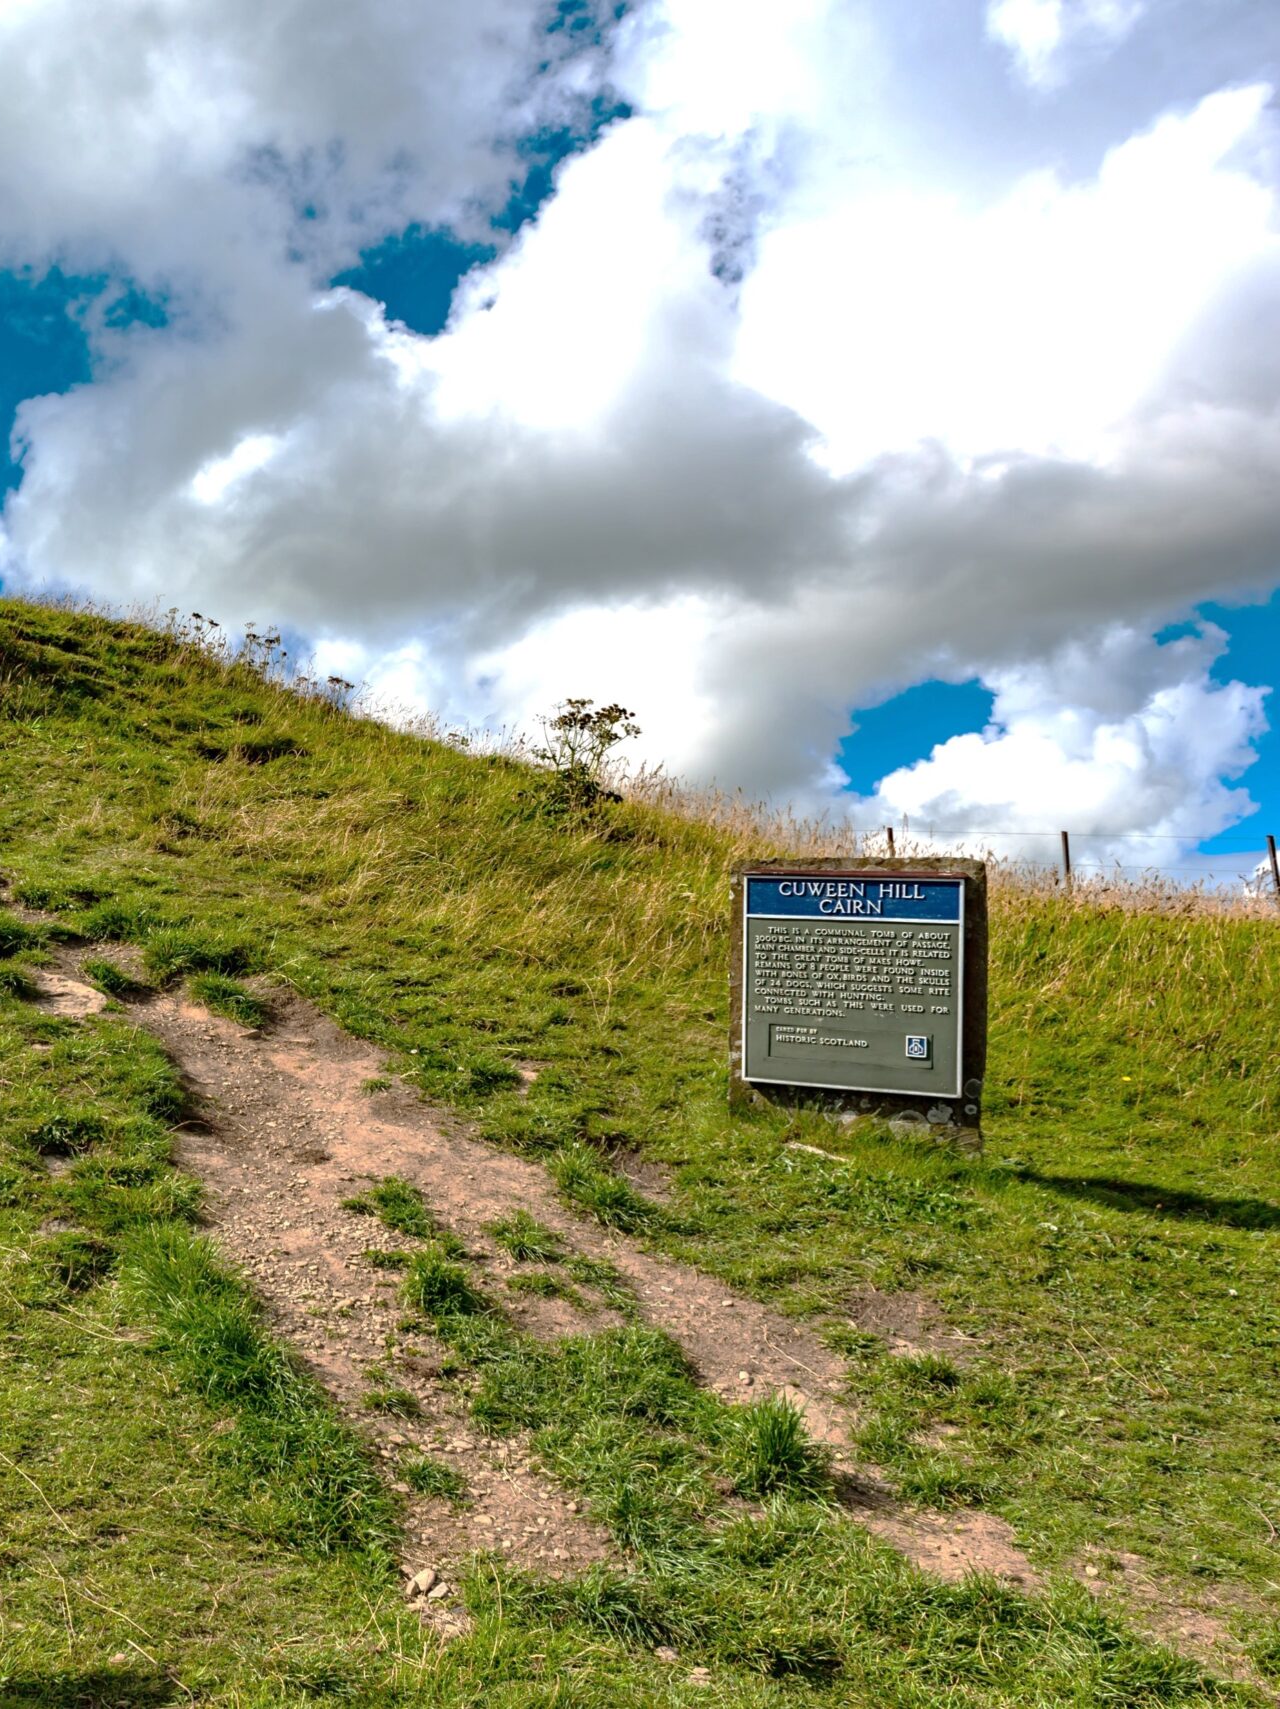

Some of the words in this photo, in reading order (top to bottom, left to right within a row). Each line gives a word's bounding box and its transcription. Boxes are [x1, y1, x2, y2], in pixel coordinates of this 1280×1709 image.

[778, 881, 864, 897] CUWEEN
[879, 883, 925, 899] HILL
[818, 899, 881, 914] CAIRN
[767, 926, 786, 934] THIS
[814, 928, 865, 936] COMMUNAL
[870, 929, 895, 938] TOMB
[901, 930, 913, 938] OF
[918, 931, 950, 940] ABOUT
[826, 937, 891, 946] ARRANGEMENT
[825, 955, 848, 963] TOMB
[869, 957, 891, 965] MAES
[912, 950, 950, 958] RELATED
[754, 960, 790, 969] REMAINS
[810, 962, 815, 970] 8
[819, 963, 849, 971] PEOPLE
[854, 965, 878, 973] WERE
[883, 966, 914, 974] FOUND
[920, 968, 949, 976] INSIDE
[755, 969, 777, 977] WITH
[781, 970, 807, 978] BONES
[918, 977, 949, 985] SKULLS
[754, 987, 806, 996] CONNECTED
[811, 990, 834, 998] WITH
[840, 992, 884, 1001] HUNTING.
[816, 981, 845, 989] WHICH
[850, 983, 892, 992] SUGGESTS
[928, 987, 949, 995] RITE
[754, 1004, 778, 1012] MANY
[783, 1006, 845, 1016] GENERATIONS.
[764, 996, 792, 1004] TOMBS
[798, 998, 820, 1006] SUCH
[826, 999, 836, 1007] AS
[843, 1000, 863, 1008] THIS
[870, 1002, 894, 1010] WERE
[900, 1004, 924, 1012] USED
[930, 1005, 949, 1013] FOR
[775, 1034, 816, 1043] HISTORIC
[819, 1037, 868, 1047] SCOTLAND
